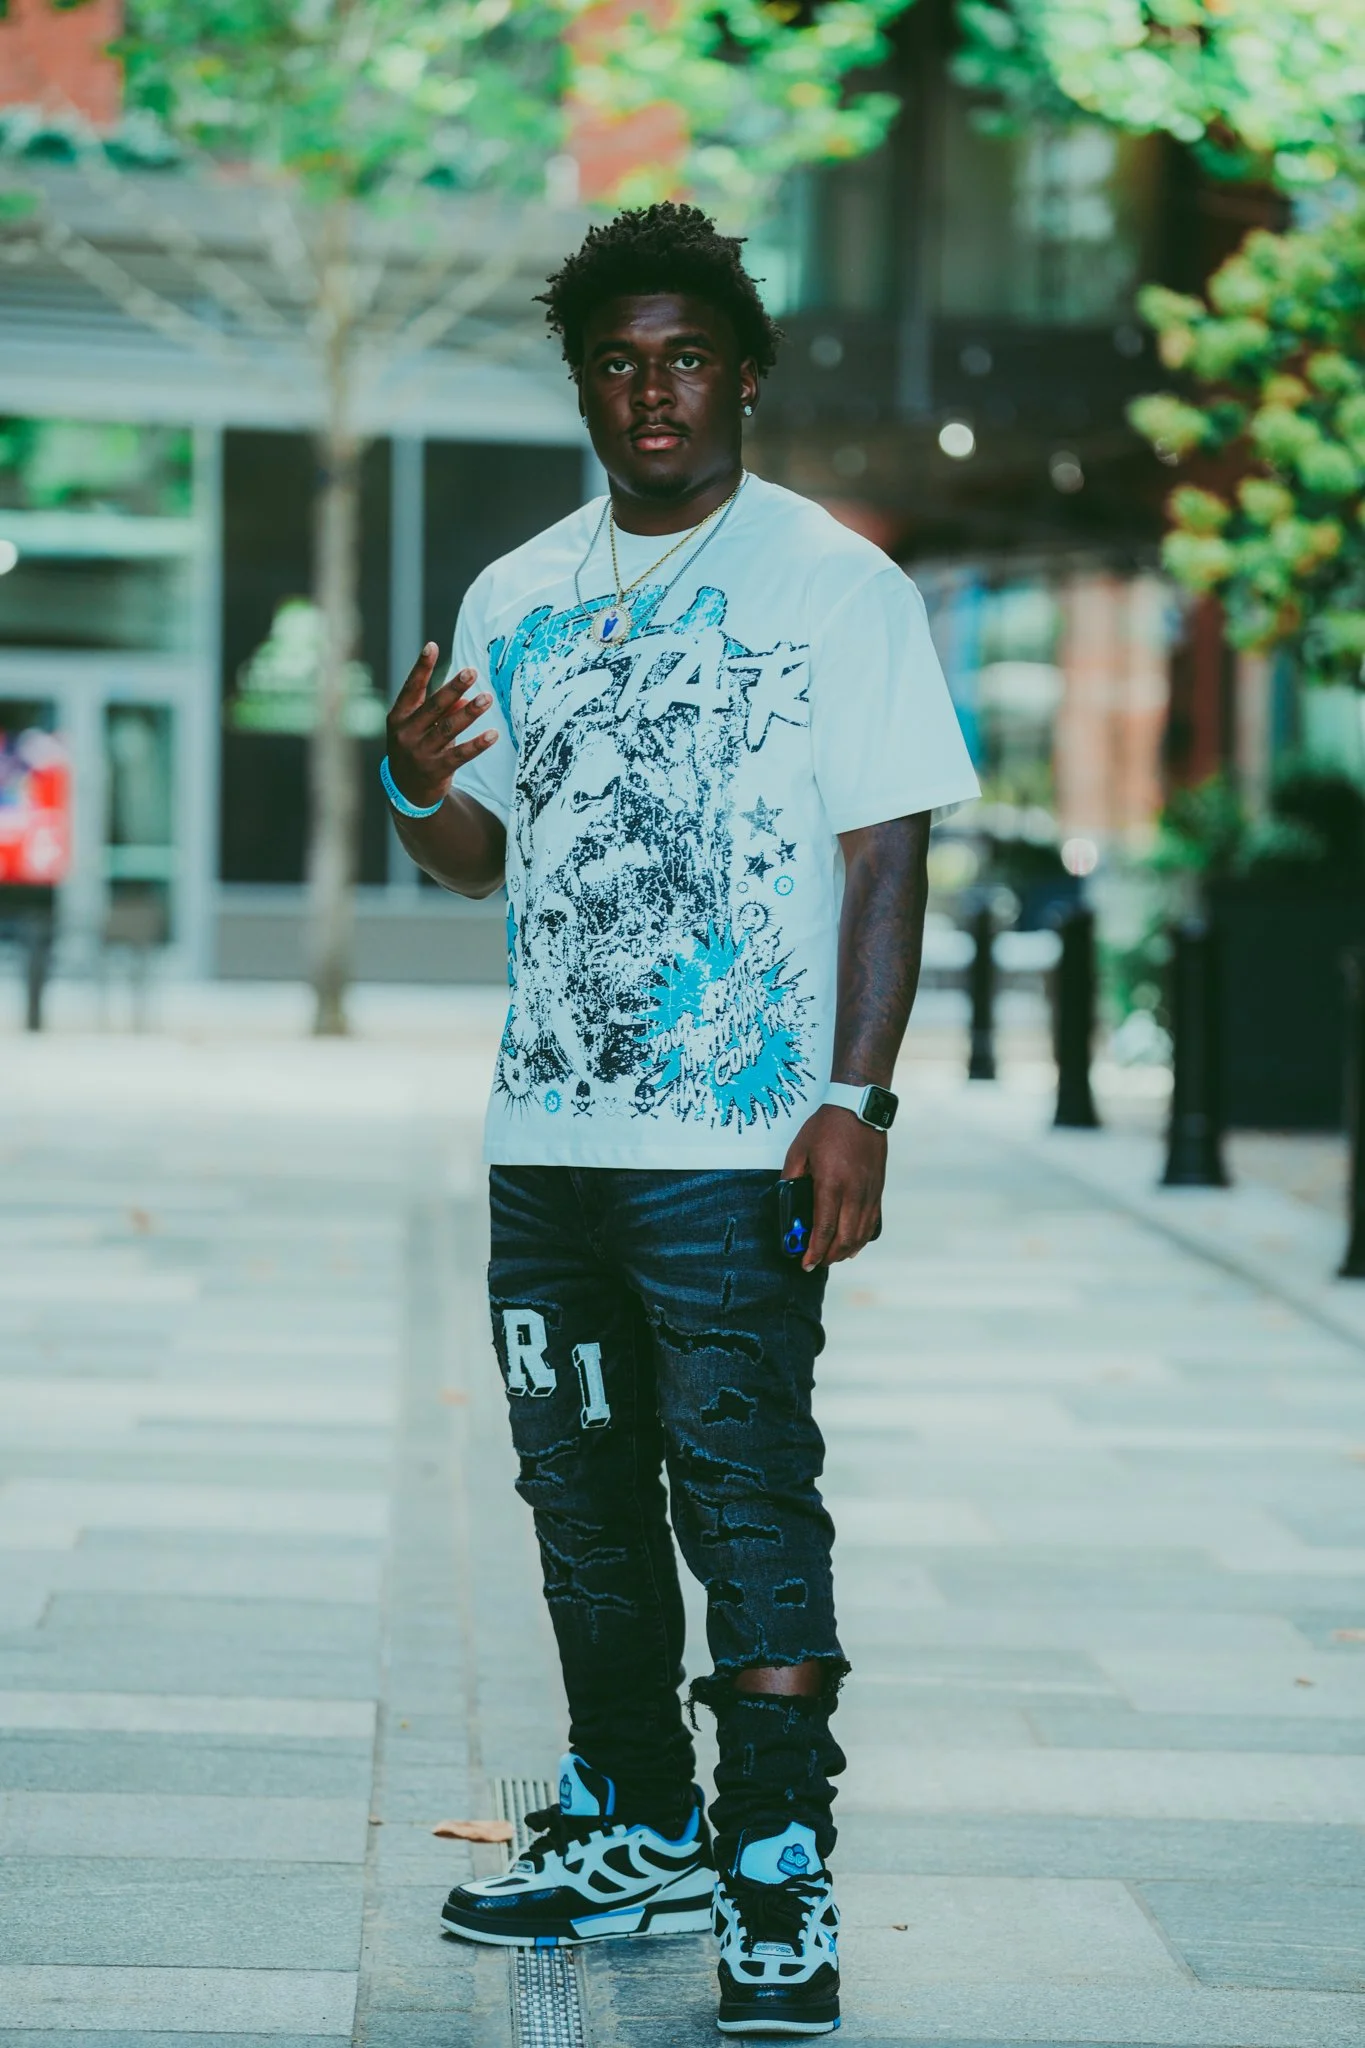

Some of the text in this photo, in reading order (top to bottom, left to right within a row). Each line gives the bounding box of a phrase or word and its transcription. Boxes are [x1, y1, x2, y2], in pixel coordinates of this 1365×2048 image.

[648, 1010, 696, 1064] YOUR
[672, 988, 800, 1115] HAS COME TRUE
[681, 979, 773, 1076] NIHTMARE
[502, 1308, 557, 1397] R
